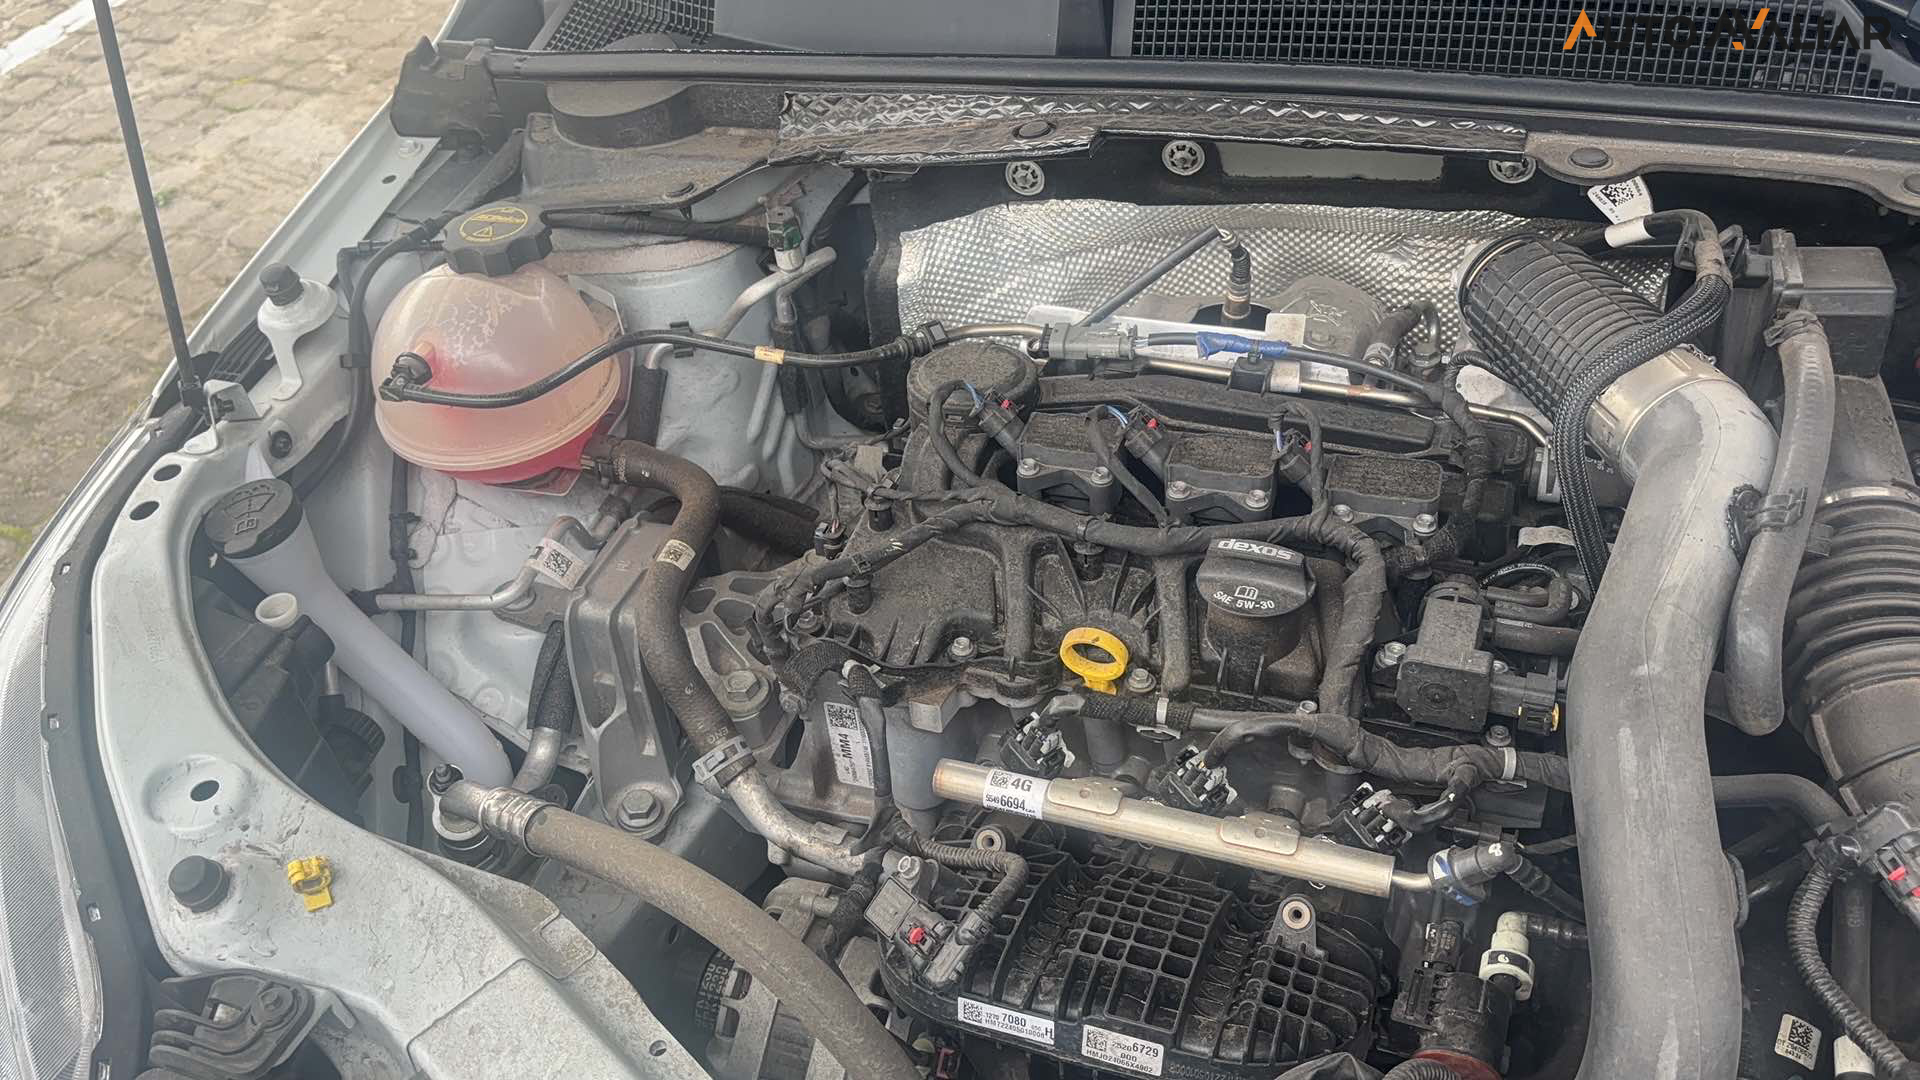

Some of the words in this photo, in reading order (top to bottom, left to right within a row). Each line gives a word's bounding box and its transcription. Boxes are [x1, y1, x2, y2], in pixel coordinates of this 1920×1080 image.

[1217, 539, 1296, 561] dexos
[1213, 591, 1234, 605] SAE
[1236, 599, 1275, 610] 5W-30
[838, 733, 853, 760] MM4
[1011, 779, 1033, 792] 4G
[1002, 1013, 1026, 1028] 7080
